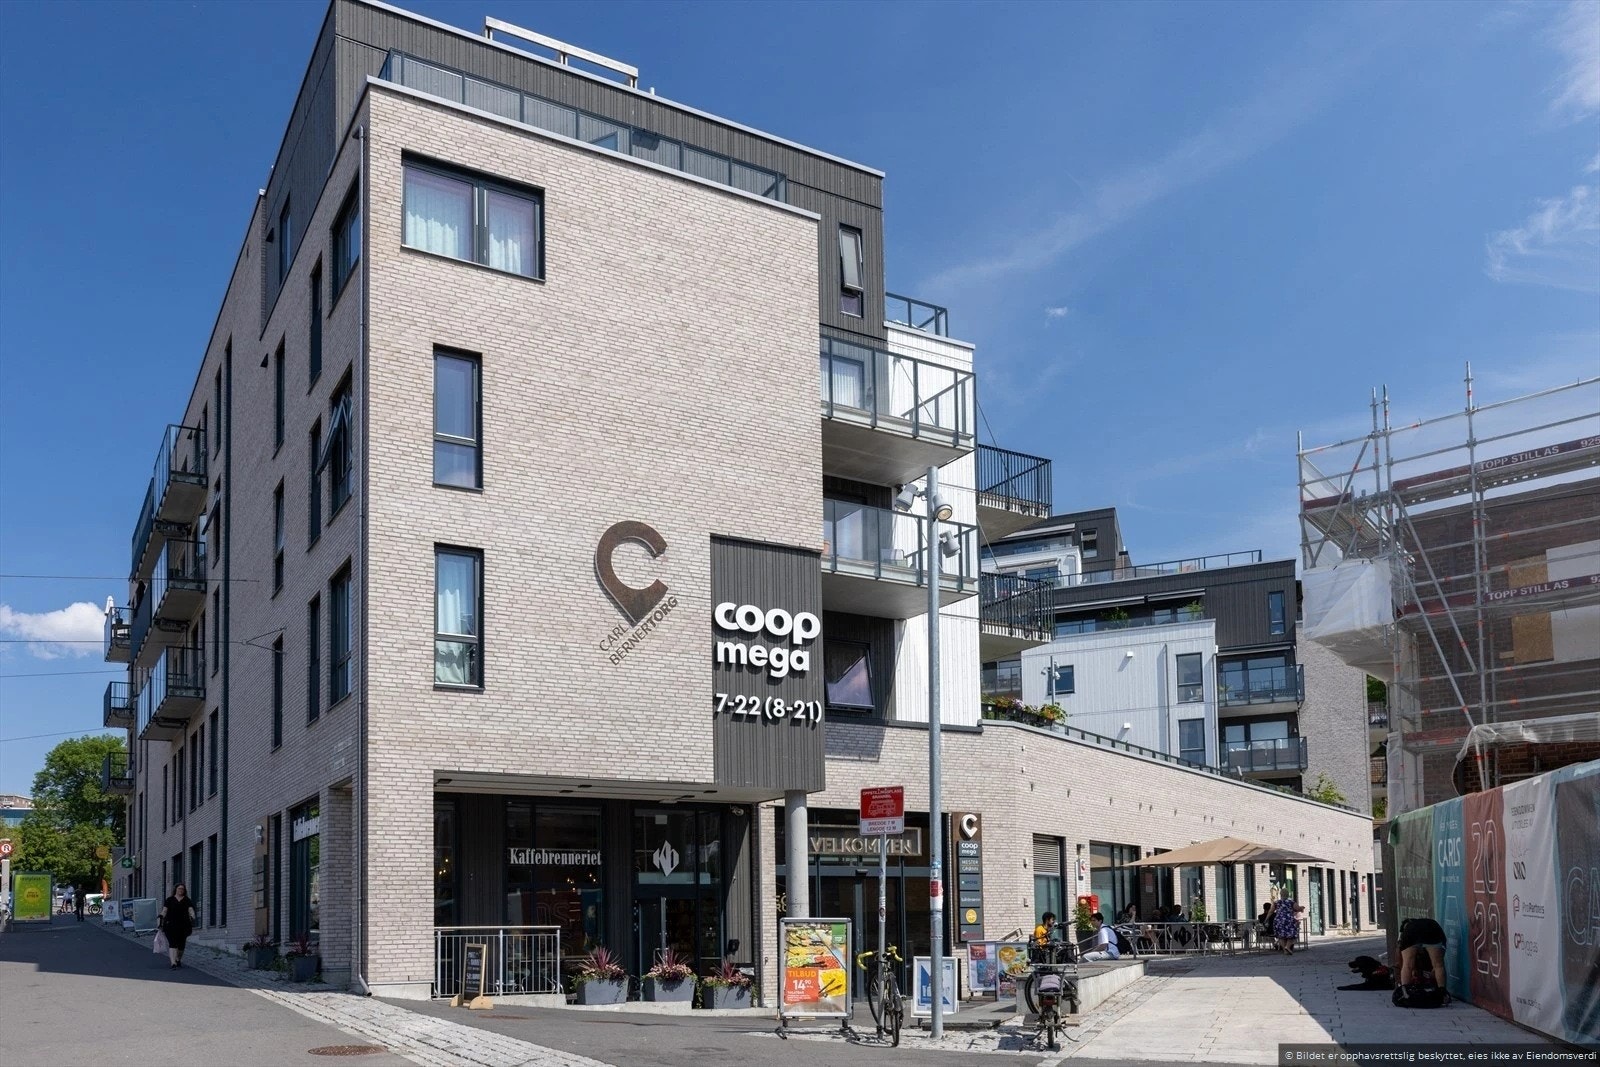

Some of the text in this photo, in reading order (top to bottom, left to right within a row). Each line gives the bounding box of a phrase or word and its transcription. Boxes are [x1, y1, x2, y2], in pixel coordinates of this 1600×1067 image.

[1480, 457, 1508, 470] TOPP
[1511, 450, 1541, 463] STILL
[1544, 445, 1560, 456] AS
[1488, 589, 1517, 600] TOPP
[1520, 584, 1551, 595] STILL
[1553, 580, 1569, 589] AS
[599, 623, 630, 652] CARL
[608, 595, 678, 667] BERNERTORG
[714, 602, 821, 645] coop
[717, 641, 810, 678] mega
[715, 693, 822, 723] 7-22 (8-21)
[510, 848, 602, 866] Kaffebrenneriet
[961, 842, 979, 850] coop
[1437, 837, 1461, 868] CARLS
[1471, 819, 1499, 894] 20
[1473, 901, 1501, 978] 23
[787, 970, 817, 978] TILBUD
